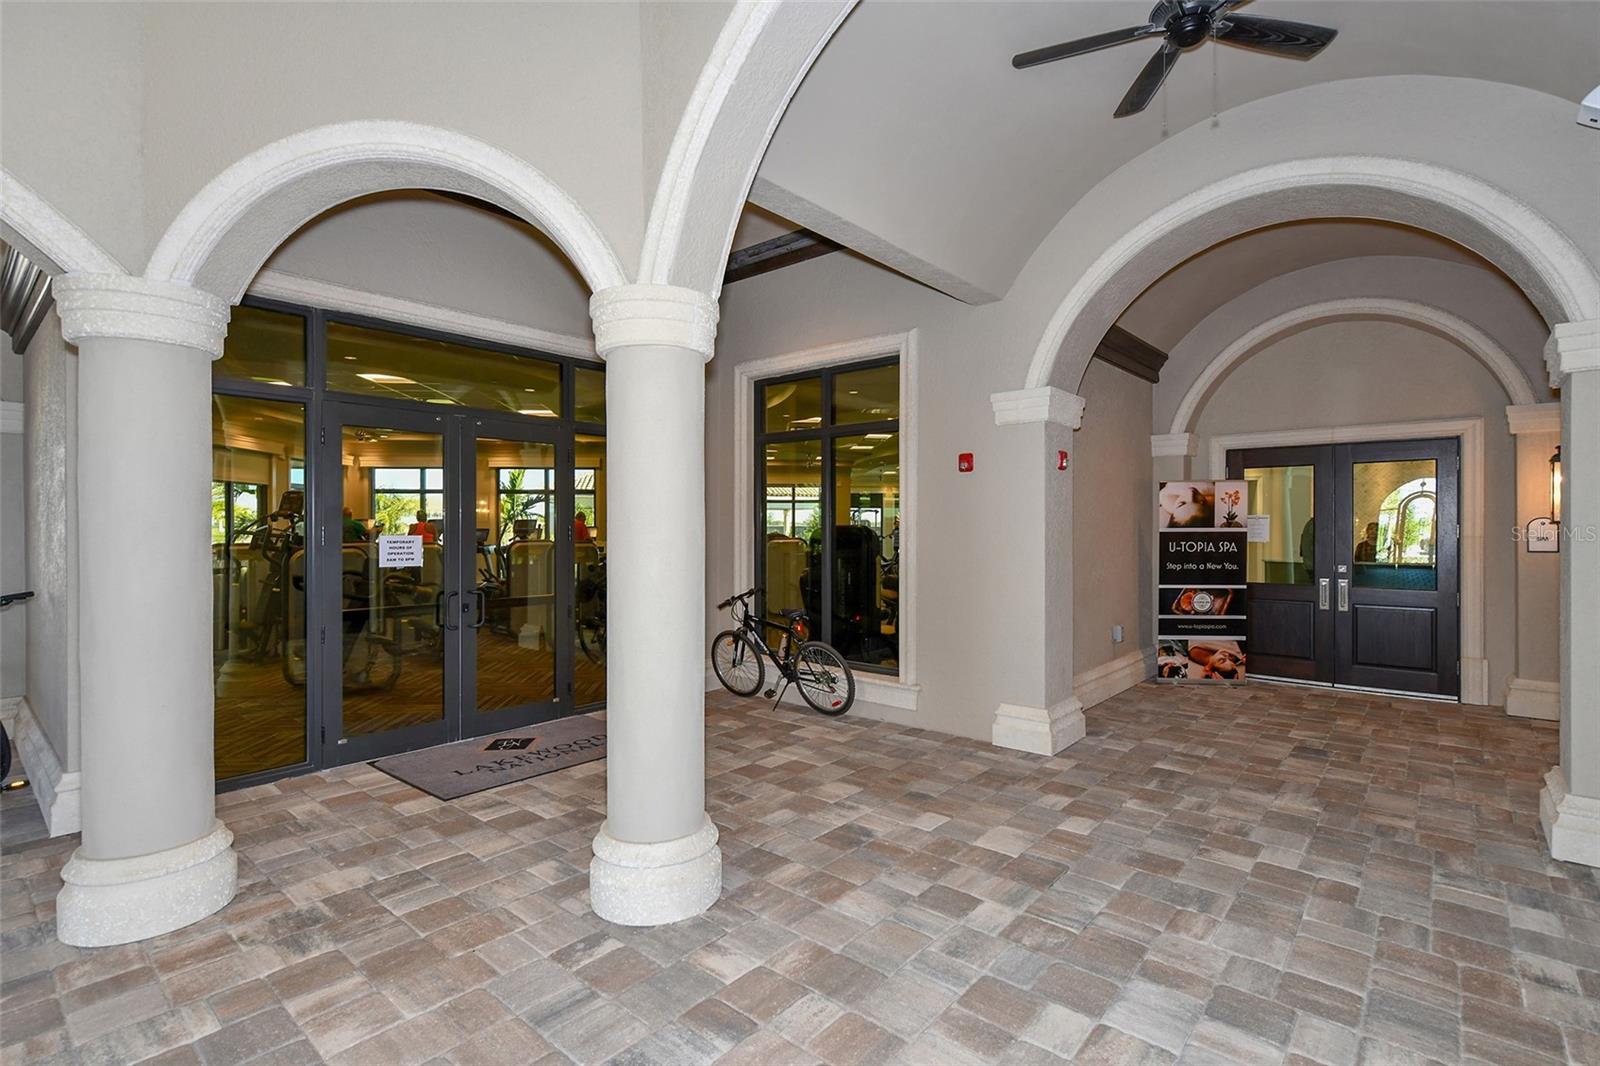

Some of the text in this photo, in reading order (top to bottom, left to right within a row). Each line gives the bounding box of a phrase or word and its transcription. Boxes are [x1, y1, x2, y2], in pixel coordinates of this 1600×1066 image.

[1168, 541, 1238, 553] U-TOPIA SPA
[1166, 562, 1182, 571] Step
[1183, 562, 1198, 570] into
[1206, 562, 1223, 570] New
[1223, 562, 1240, 570] You.
[453, 734, 608, 776] LAKEWOOD
[489, 742, 605, 774] NATIONAL
